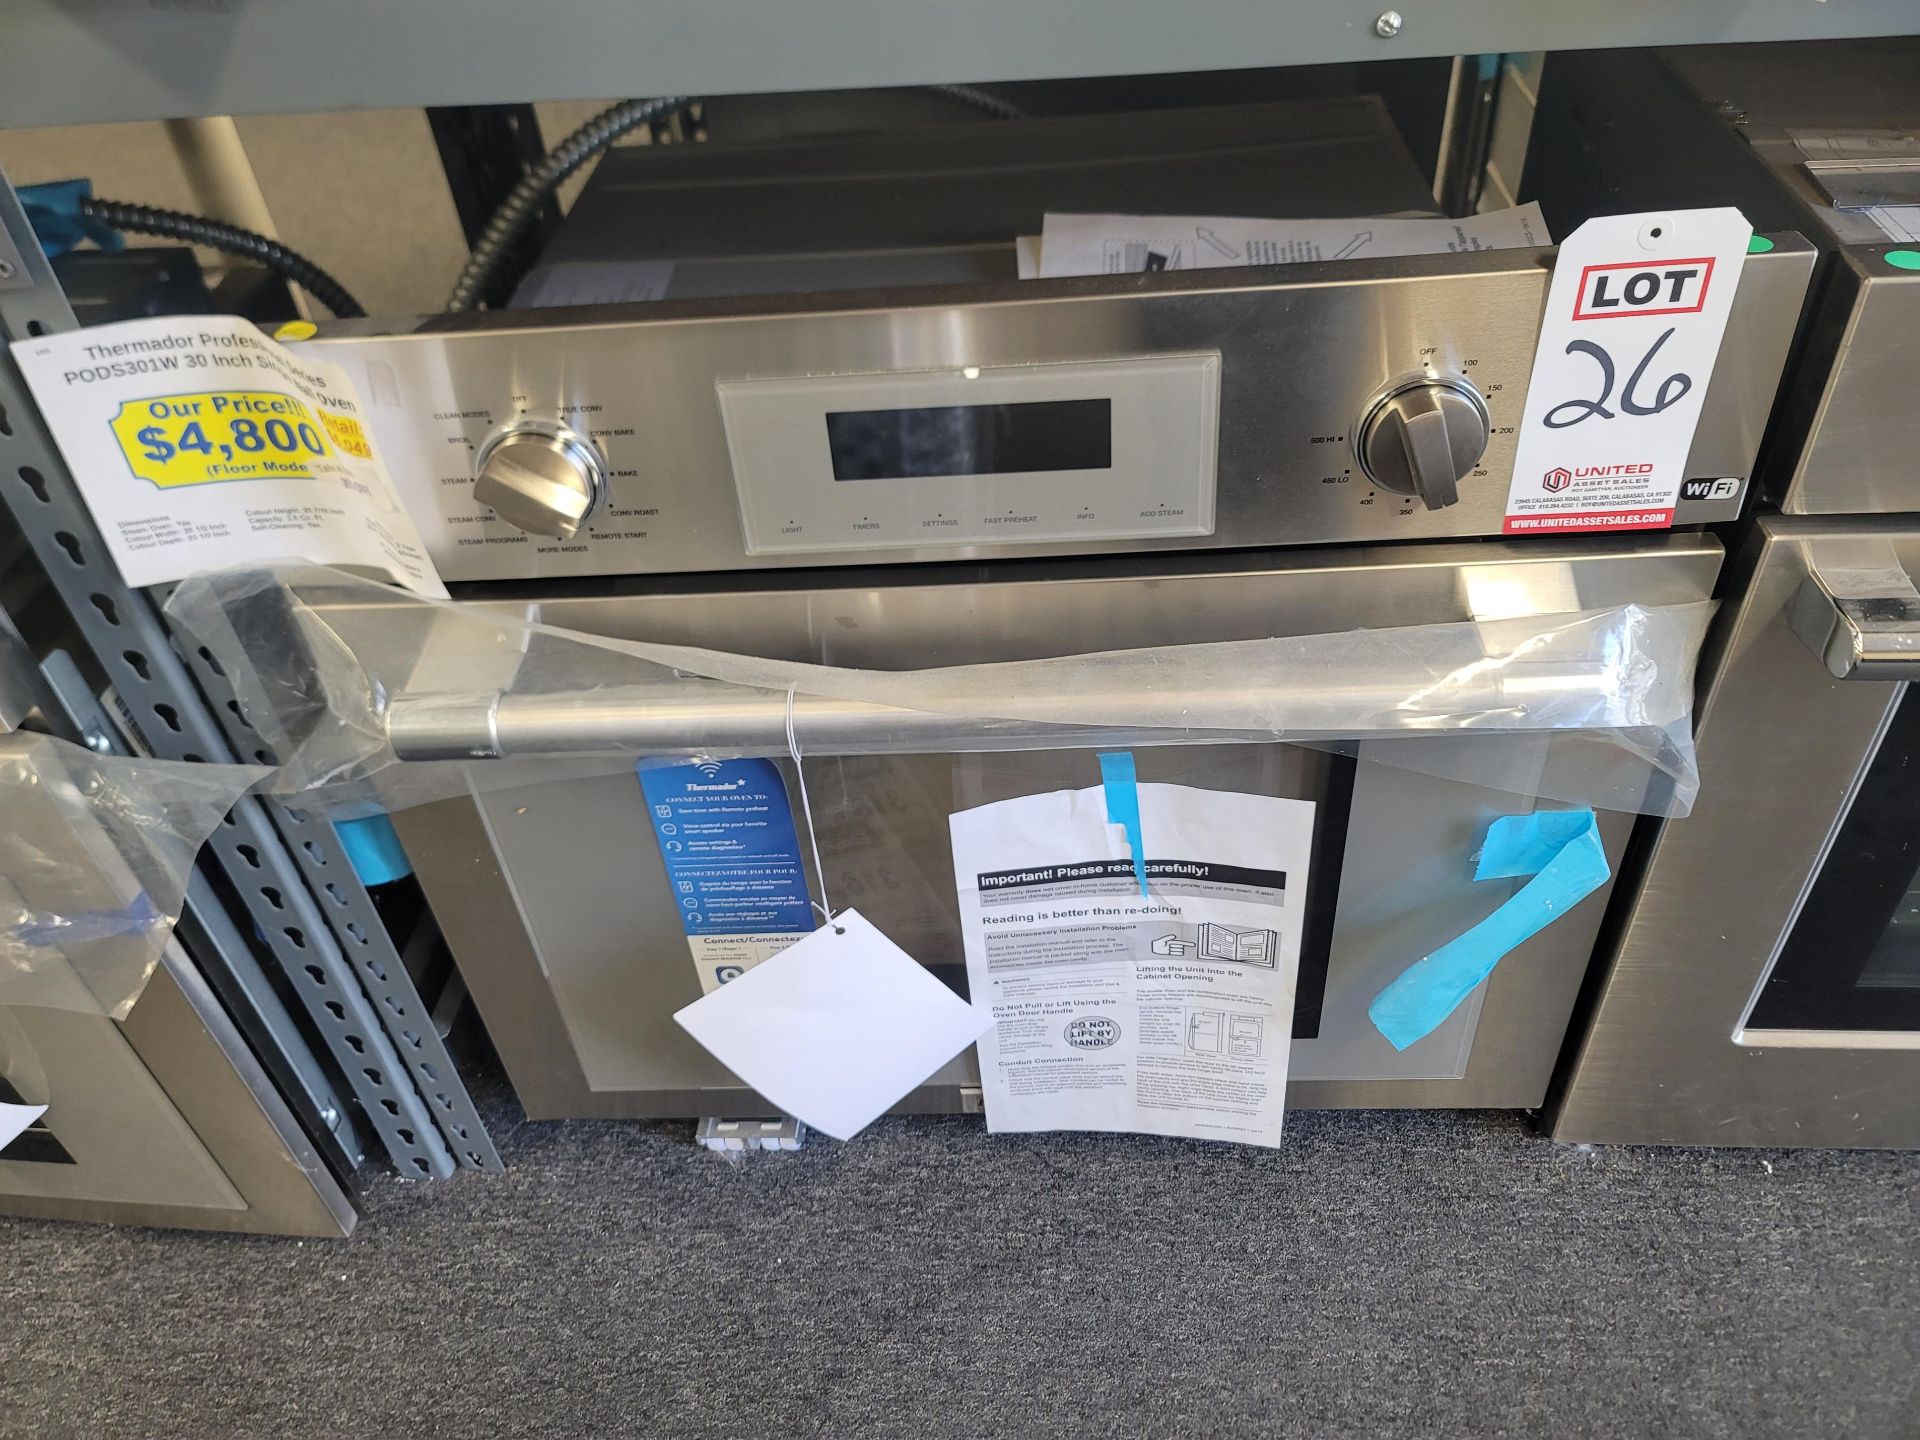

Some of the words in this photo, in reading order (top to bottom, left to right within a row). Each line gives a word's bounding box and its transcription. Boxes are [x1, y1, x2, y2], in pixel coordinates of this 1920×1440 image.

[1592, 269, 1698, 307] LOT
[83, 334, 194, 360] Thermador
[64, 356, 179, 386] PODS301W
[184, 354, 208, 368] 30
[212, 353, 253, 368] Inch
[1543, 328, 1692, 428] 26
[149, 401, 202, 420] Our
[580, 404, 602, 412] CONV
[434, 411, 460, 420] CLEAN
[462, 410, 490, 418] MODES
[137, 418, 325, 463] $4,800
[206, 459, 257, 478] (Floor
[1575, 464, 1653, 477] UNITED
[634, 508, 658, 516] ROAST
[448, 516, 473, 524] STEAM
[1004, 516, 1038, 524] PREHEAT
[1510, 514, 1666, 528] WWW.UNITEDASSETSALES.COM
[591, 532, 623, 540] REMOTE
[781, 526, 803, 534] LIGHT
[485, 536, 528, 545] PROGRAMS
[561, 545, 589, 553] MODES
[685, 783, 737, 791] Thermador
[981, 870, 1052, 886] Important!
[1058, 865, 1103, 878] Please
[1145, 863, 1209, 876] carefully!
[983, 914, 1034, 924] Reading
[1038, 912, 1048, 920] is
[1053, 909, 1089, 918] better
[1093, 906, 1120, 915] than
[1124, 904, 1182, 915] re-doing!
[1011, 929, 1057, 938] Unnecessary
[1059, 926, 1100, 934] Installation
[1174, 974, 1213, 982] Opening
